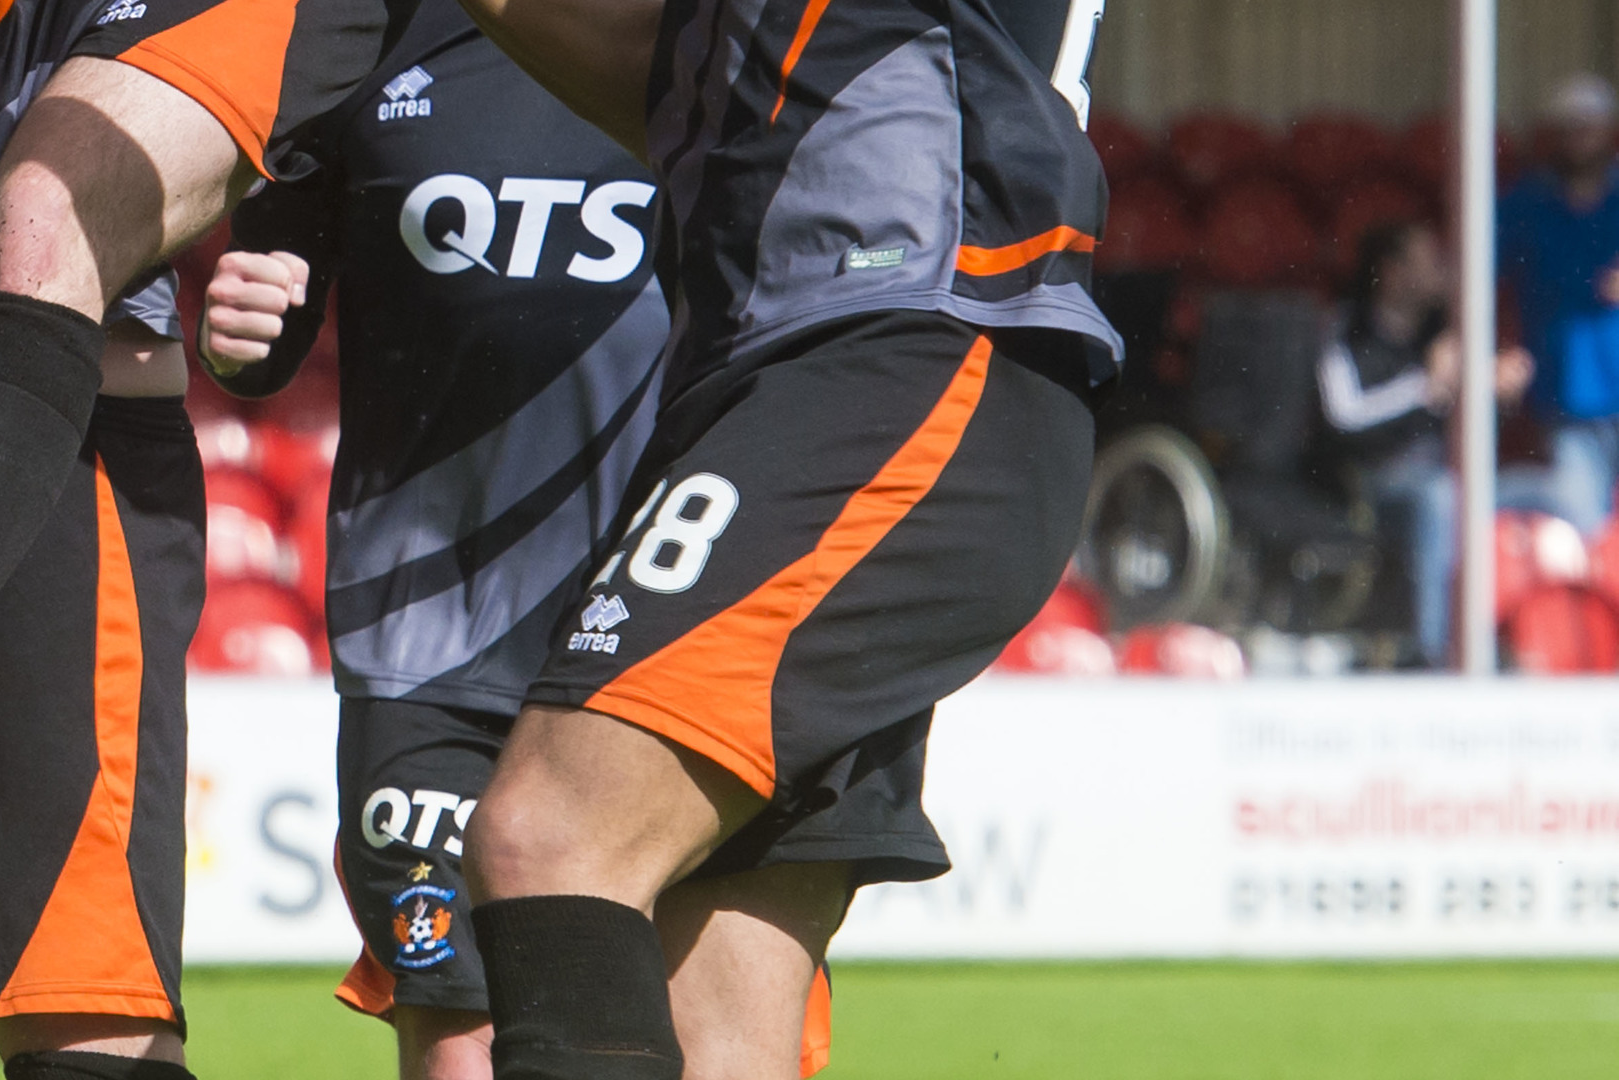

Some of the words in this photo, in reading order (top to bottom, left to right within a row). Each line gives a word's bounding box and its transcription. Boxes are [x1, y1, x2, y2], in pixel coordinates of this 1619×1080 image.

[377, 97, 432, 121] errea
[398, 172, 658, 284] QTS
[566, 630, 621, 656] errea
